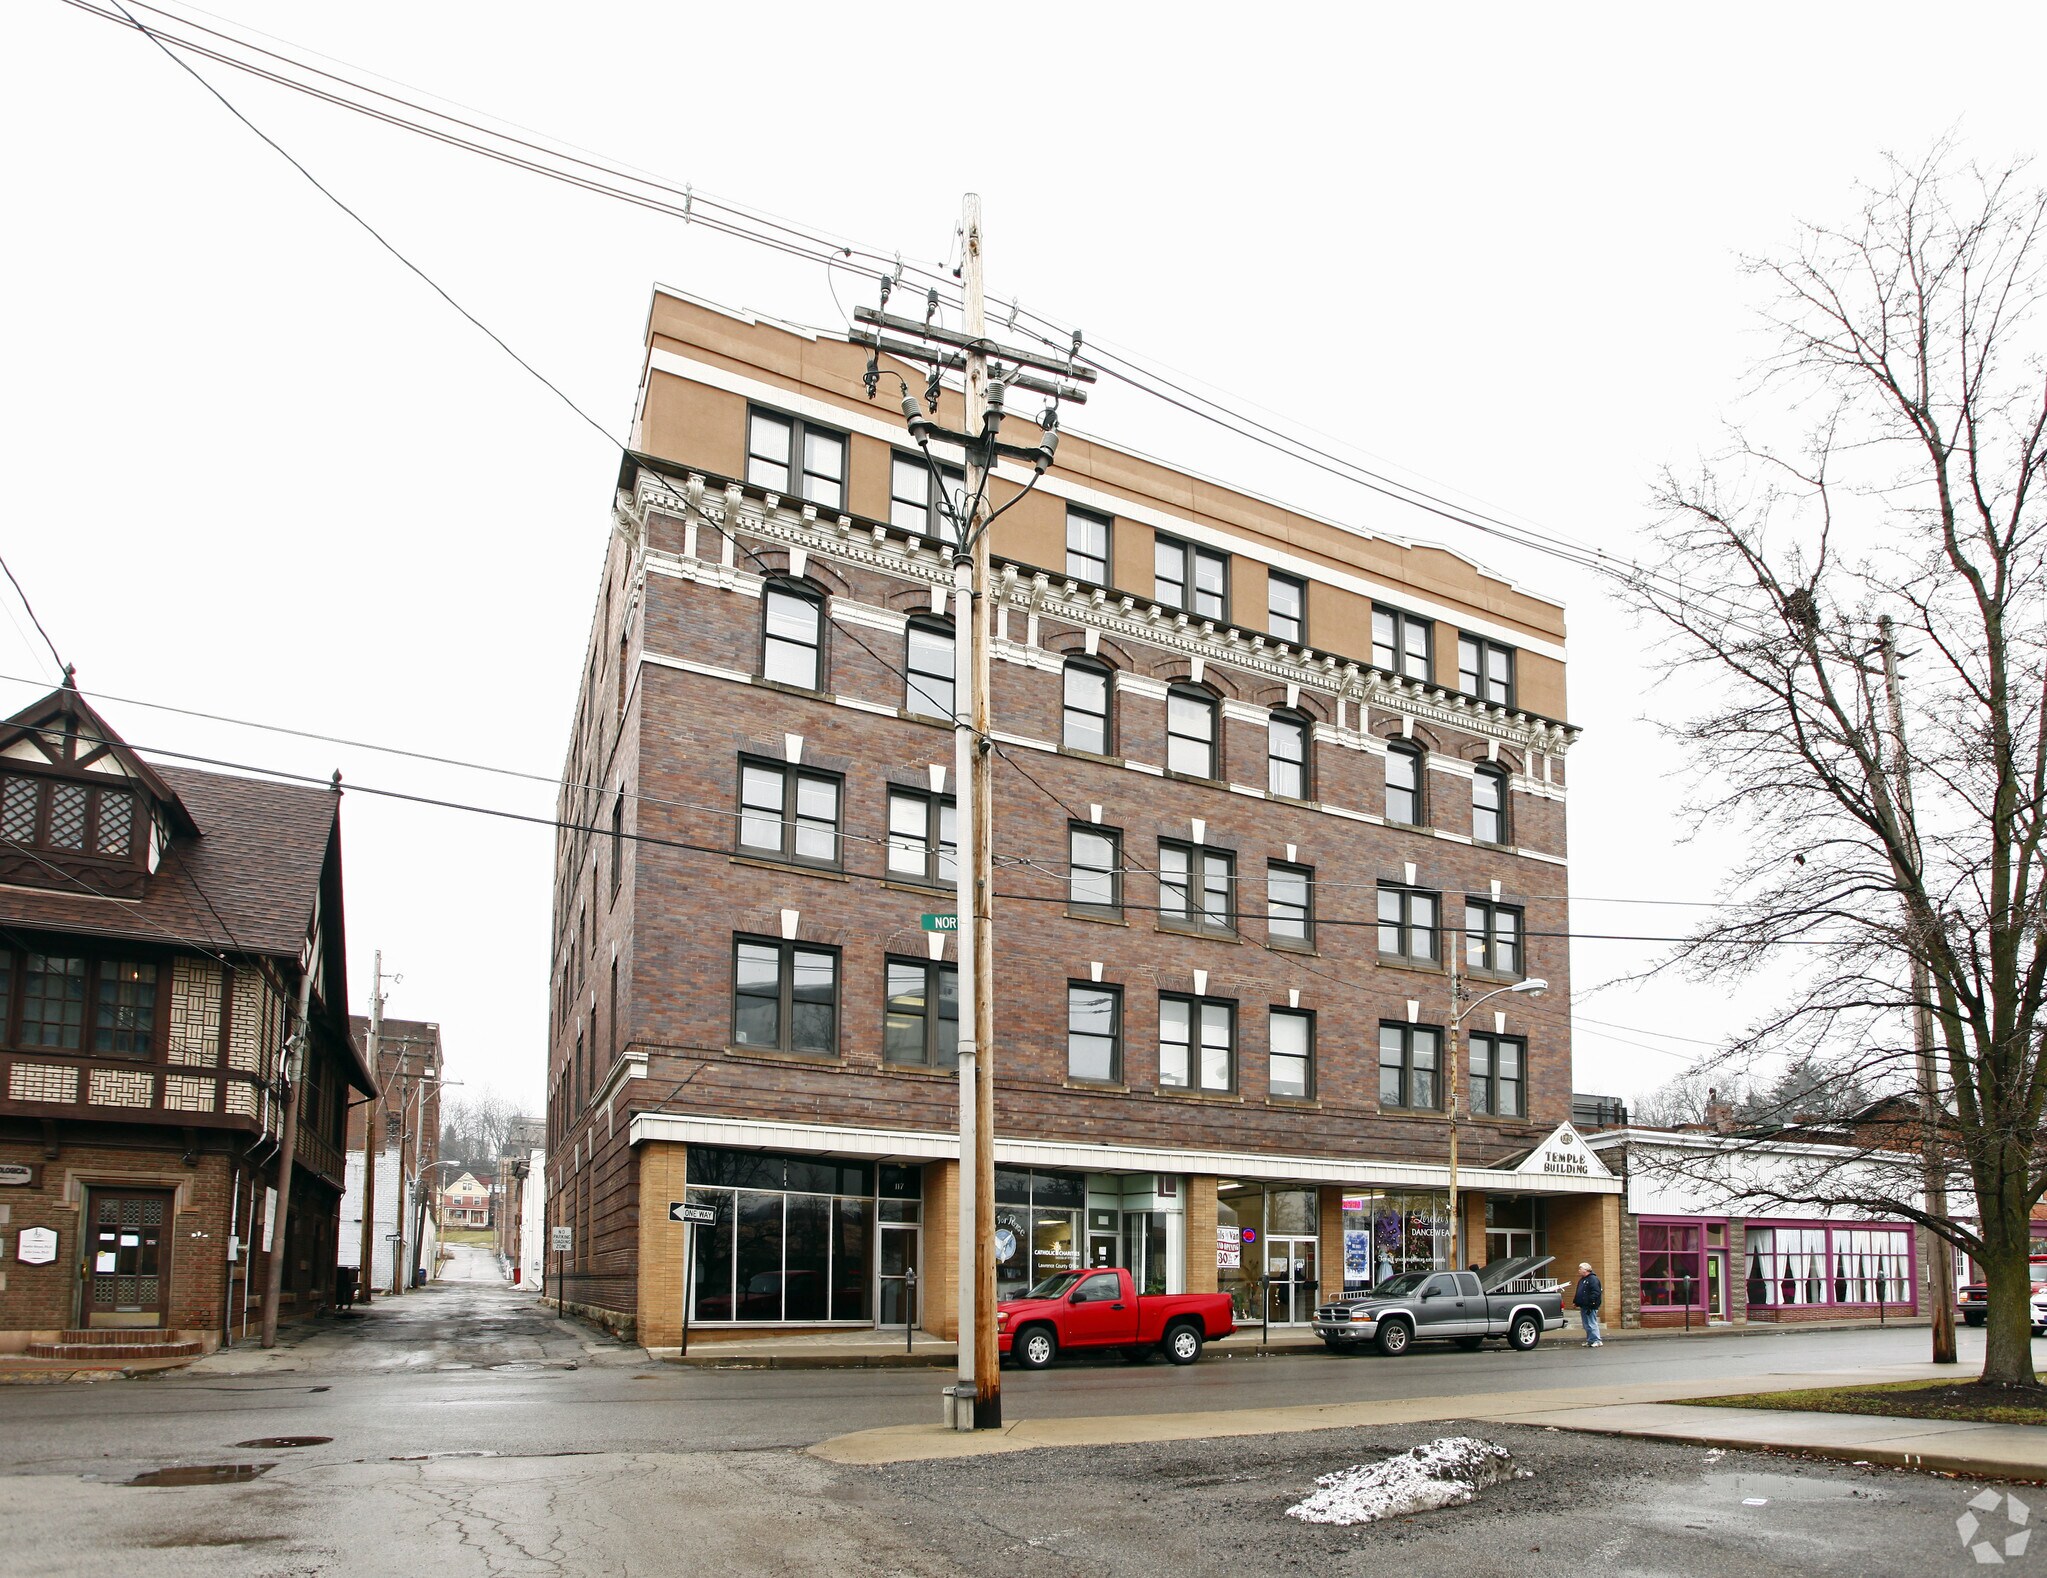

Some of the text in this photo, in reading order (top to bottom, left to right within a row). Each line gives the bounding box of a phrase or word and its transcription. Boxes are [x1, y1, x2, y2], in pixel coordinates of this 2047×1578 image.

[934, 916, 959, 929] NOR
[1545, 1151, 1586, 1164] TEMPLE
[1543, 1162, 1588, 1174] BUILDING
[684, 1209, 712, 1219] ONE WAY
[1411, 1228, 1451, 1237] DANCEWEA
[1034, 1249, 1057, 1257] CATHOLIC
